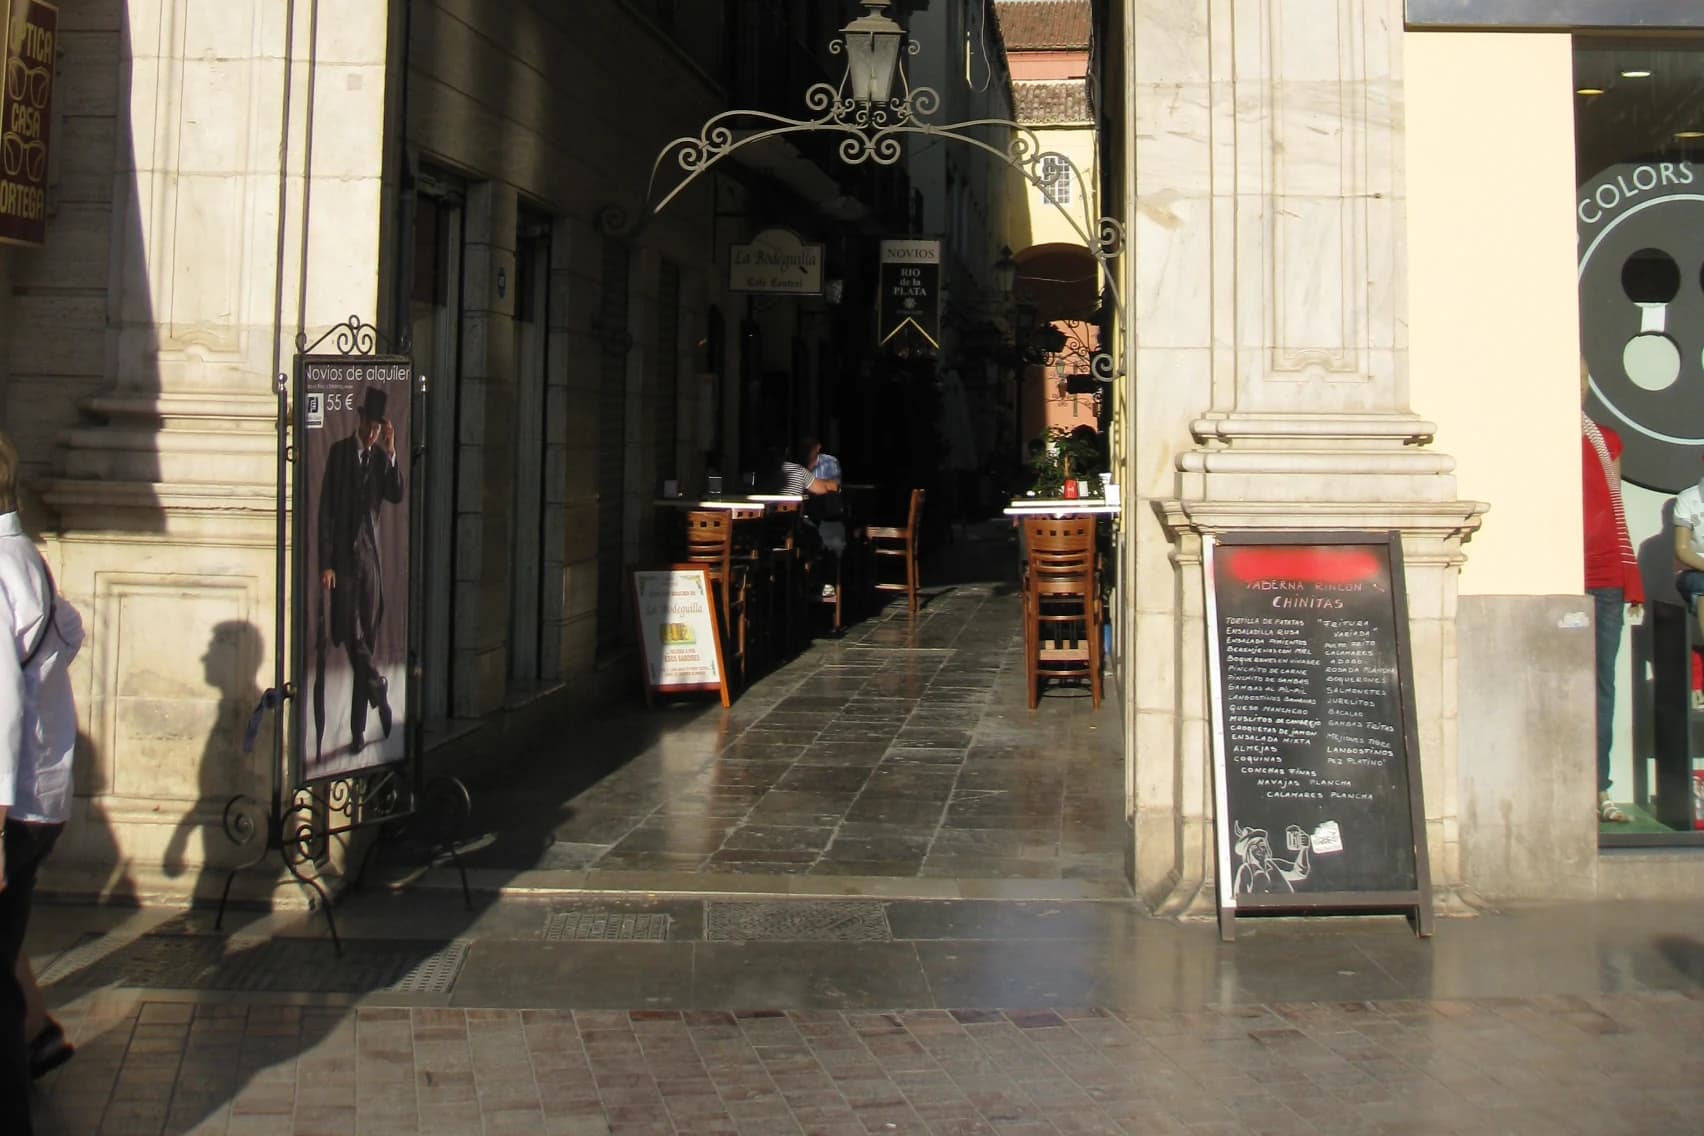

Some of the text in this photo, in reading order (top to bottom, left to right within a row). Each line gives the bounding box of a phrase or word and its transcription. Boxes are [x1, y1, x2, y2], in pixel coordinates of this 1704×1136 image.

[11, 102, 40, 137] CASA
[1578, 161, 1692, 223] COLORS
[0, 179, 44, 219] ORTEGA
[887, 249, 935, 258] NOVIOS
[900, 268, 921, 277] RIO
[900, 278, 921, 286] de la
[893, 287, 928, 296] PLATA
[306, 365, 410, 384] Novios de alquiler
[1272, 594, 1344, 610] CHINITAS
[1225, 617, 1260, 625] TORTILLA
[1275, 619, 1305, 627] PATATAS
[1226, 627, 1274, 636] ENSALADILLA
[1226, 636, 1265, 645] ENSALADA
[1326, 676, 1386, 686] BOQUERONES
[1228, 683, 1263, 692] GAMBAS
[1326, 687, 1387, 696] SALMONETES
[1327, 697, 1375, 707] JURELITOS
[1229, 704, 1308, 715] QUESO MANCHEGO
[1228, 714, 1273, 723] MUSLITOS
[1328, 719, 1363, 728] GAMBAS
[1230, 725, 1277, 734] CROQUETAS
[1231, 734, 1311, 745] ENSALADA MIXTA
[1233, 743, 1278, 754] ALMEJAS
[1326, 746, 1393, 757] LANGOSTINOS
[1233, 756, 1282, 764] COQUINAS
[1240, 766, 1285, 774] CONCHAS
[1257, 778, 1351, 789] NAVAJAS PLANCHA
[1266, 791, 1373, 800] CALAMARES PLANCHA
